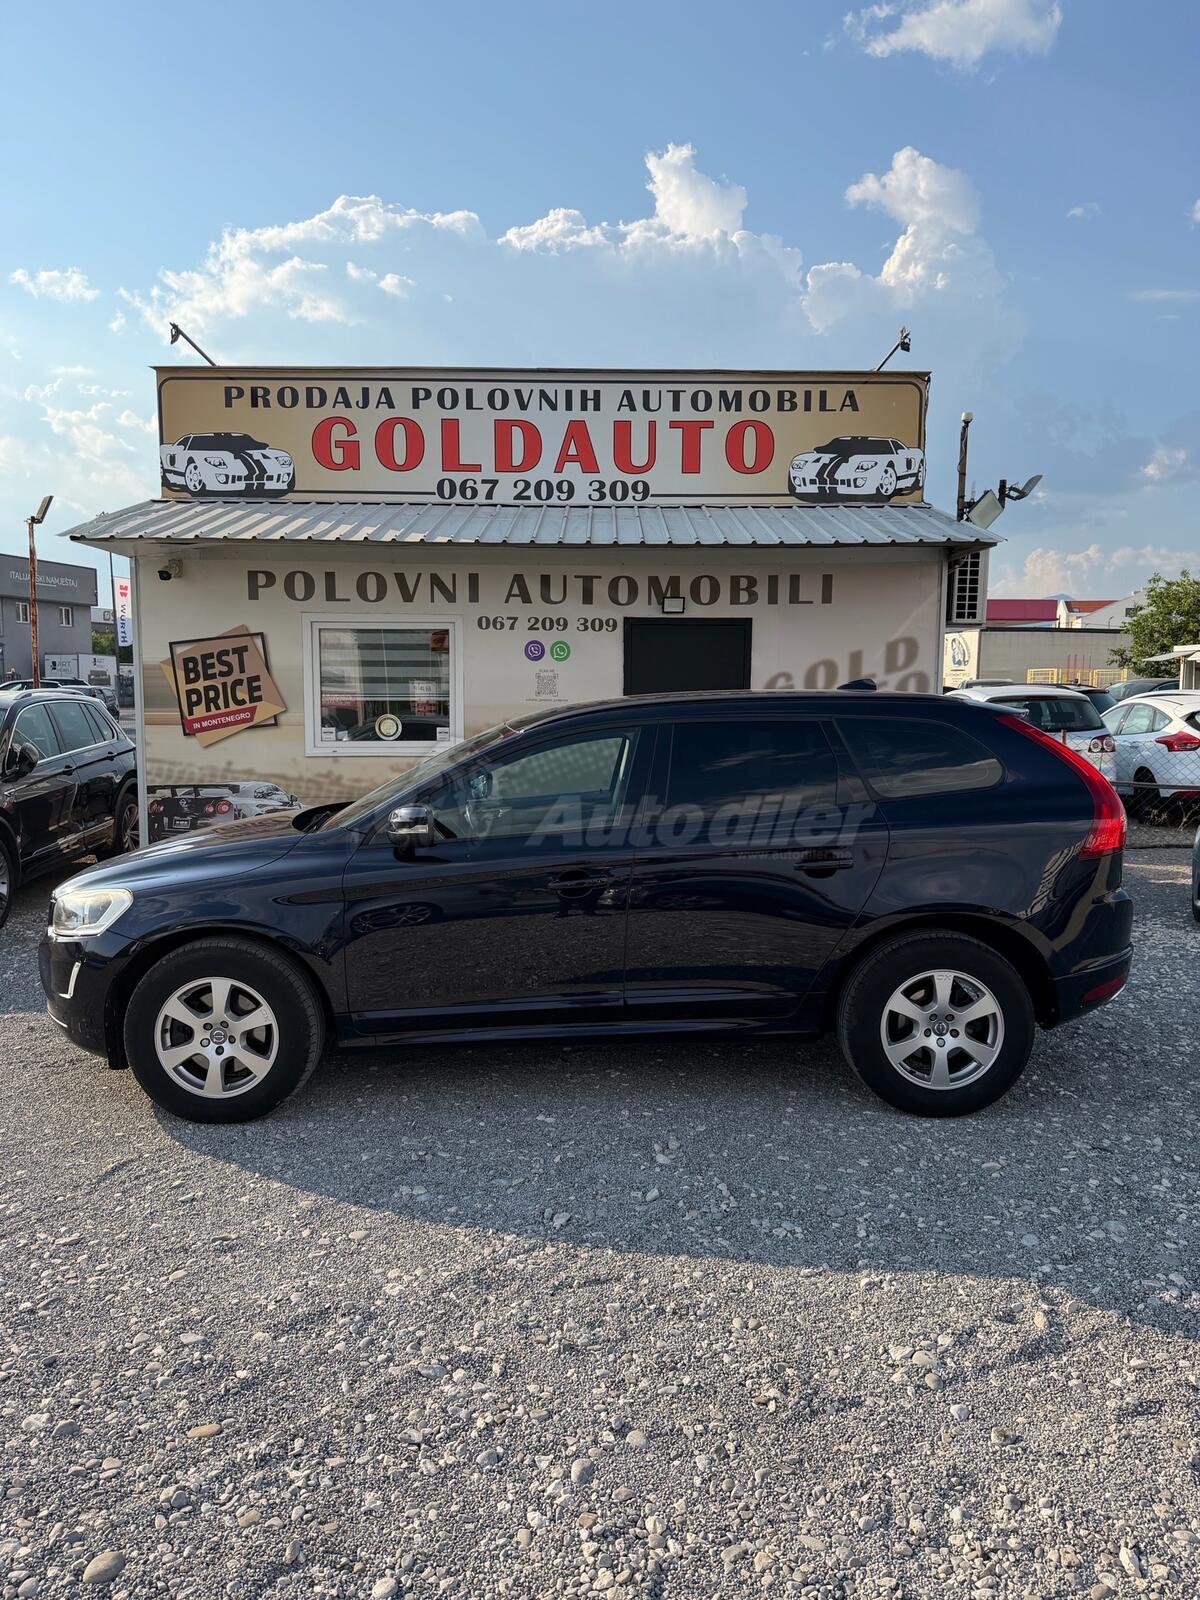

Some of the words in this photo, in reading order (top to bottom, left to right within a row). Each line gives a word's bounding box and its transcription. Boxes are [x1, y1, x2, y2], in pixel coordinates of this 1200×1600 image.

[224, 386, 396, 410] PRODAJA
[411, 387, 601, 412] POLOVNIH
[617, 389, 860, 412] AUTOMOBILA
[311, 416, 775, 475] GOLDAUTO
[436, 478, 499, 500] 067
[513, 478, 576, 501] 209
[588, 479, 650, 502] 309
[247, 570, 480, 603] POLOVNI
[504, 573, 833, 606] AUTOMOBILI
[477, 615, 519, 631] 067
[527, 616, 569, 632] 209
[576, 617, 618, 632] 309
[182, 645, 249, 685] BEST
[763, 636, 919, 690] GOLD
[185, 675, 263, 716] PRICE
[202, 711, 251, 728] MONTENEGRO
